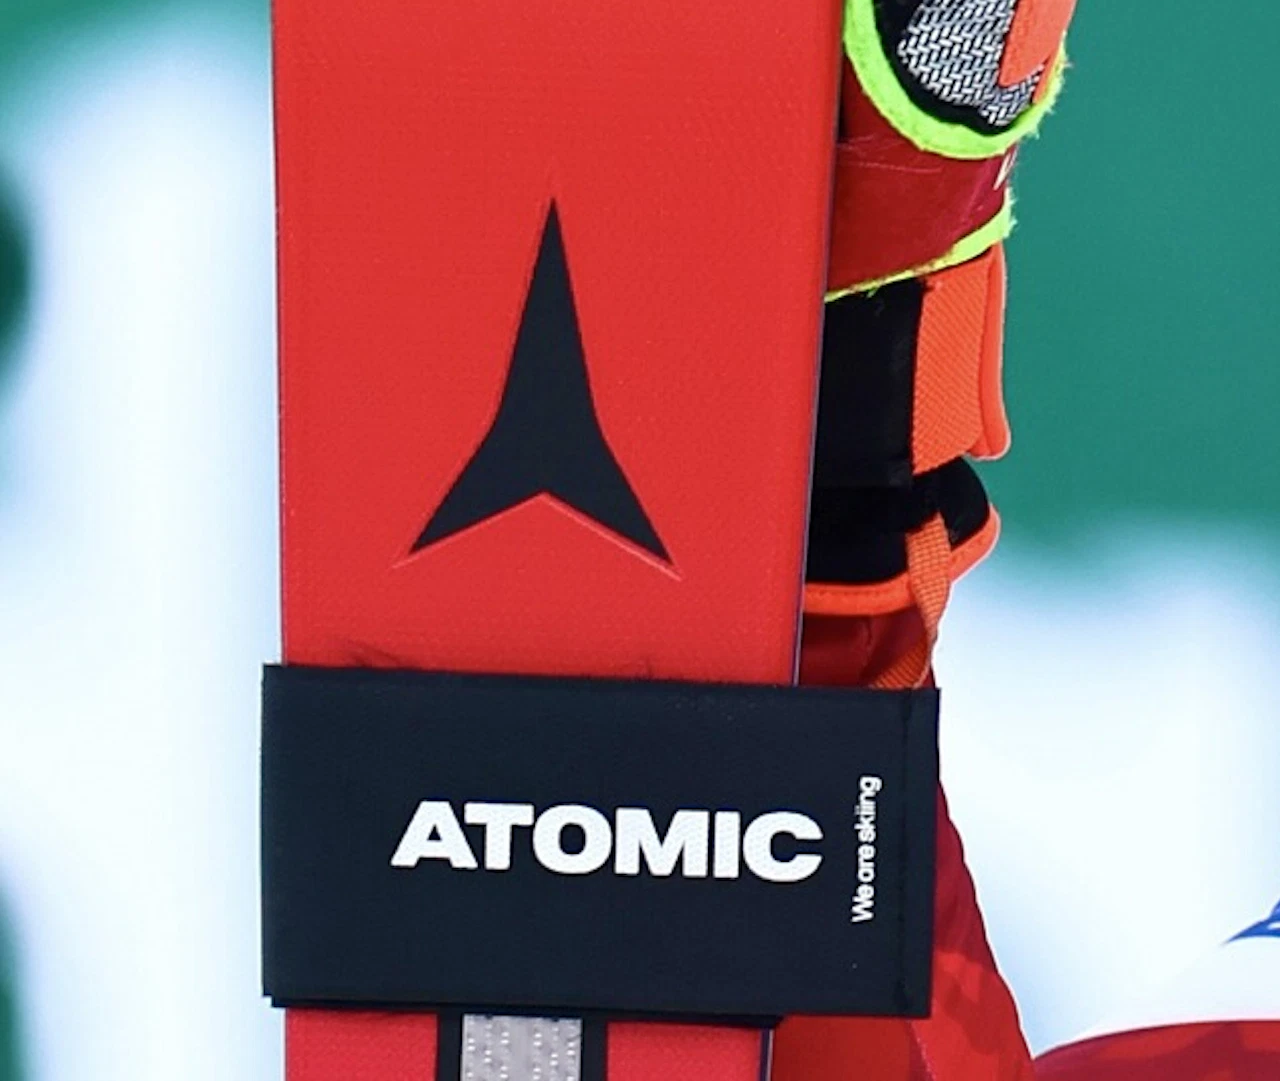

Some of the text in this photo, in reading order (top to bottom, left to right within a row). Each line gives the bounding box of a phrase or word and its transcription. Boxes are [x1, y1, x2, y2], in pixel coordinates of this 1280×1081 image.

[390, 800, 823, 883] ATOMIC
[854, 776, 883, 843] skiing
[851, 883, 875, 923] We
